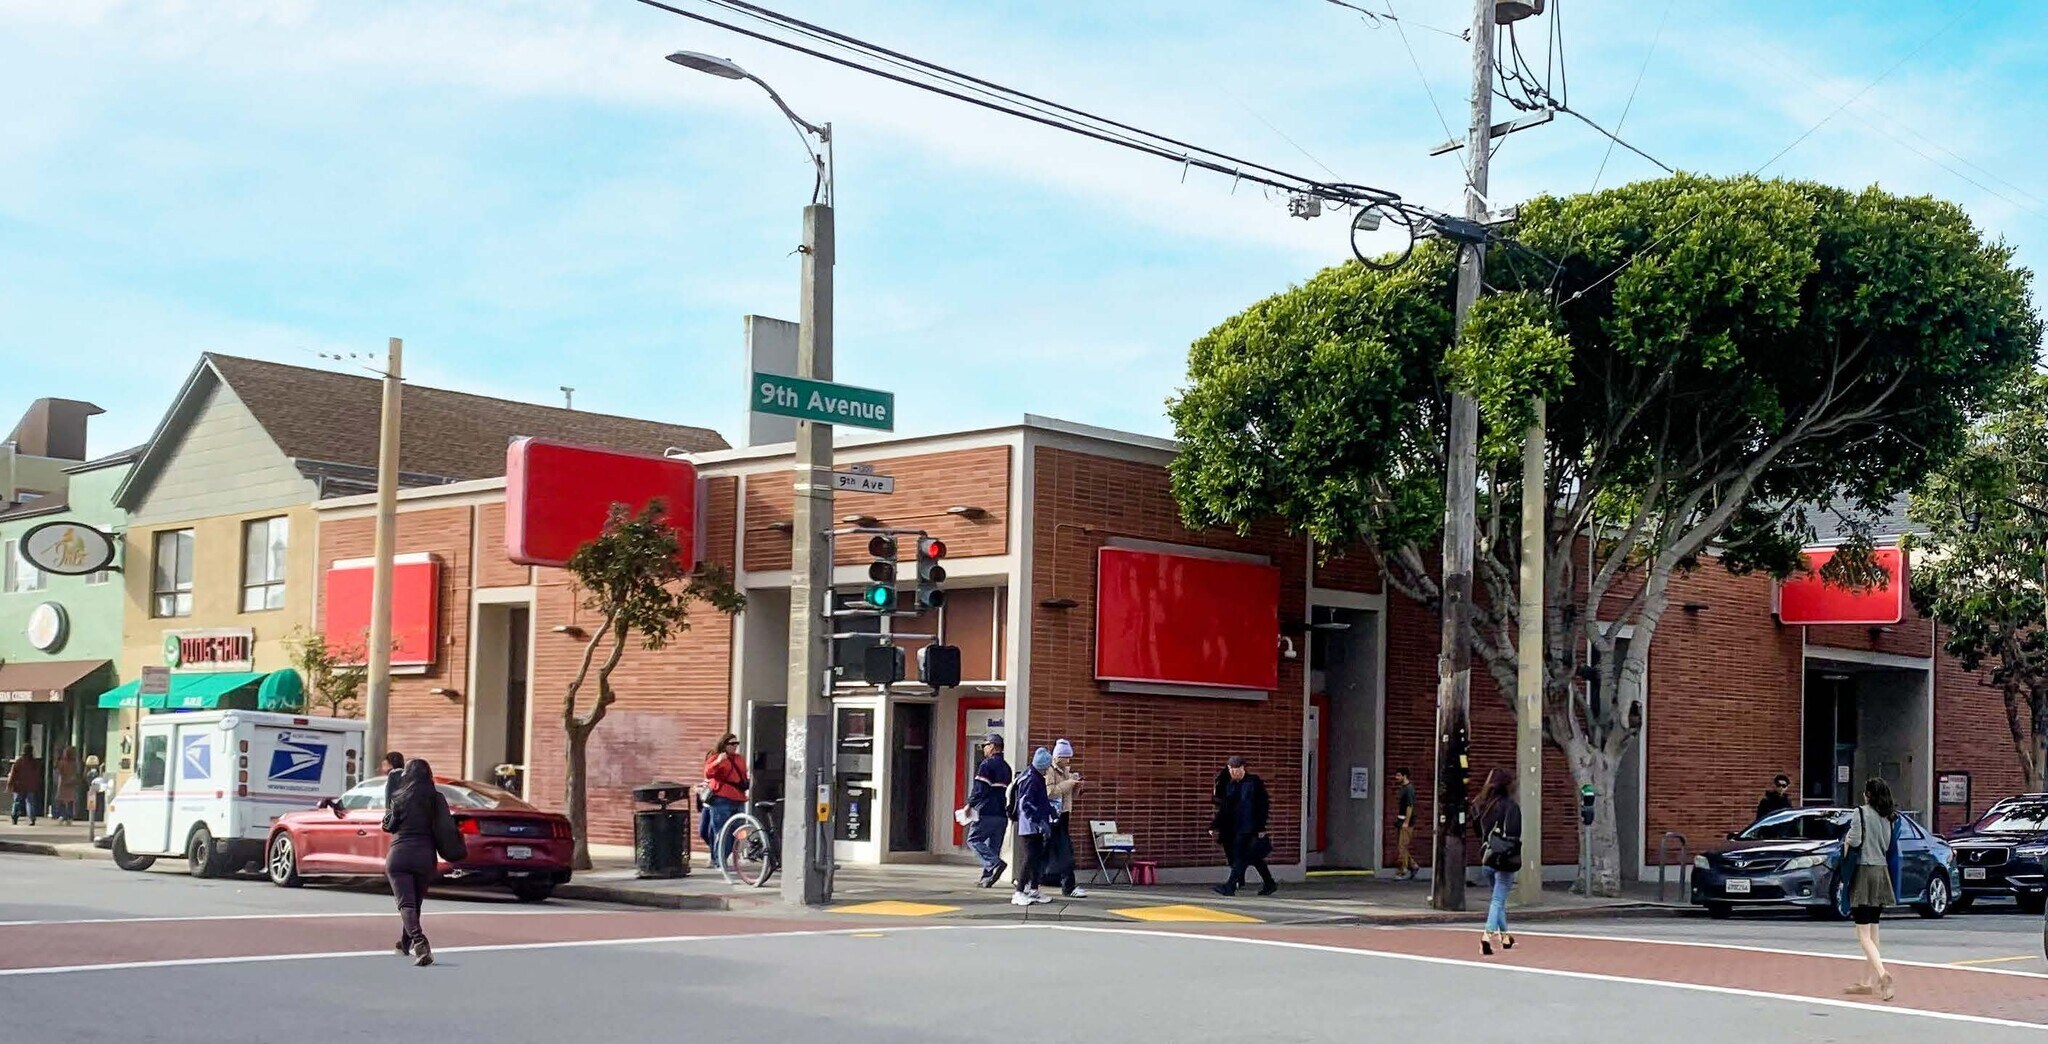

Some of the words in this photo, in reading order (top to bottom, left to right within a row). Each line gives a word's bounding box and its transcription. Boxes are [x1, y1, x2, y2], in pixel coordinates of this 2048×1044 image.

[760, 382, 799, 408] 9th
[807, 390, 887, 421] Avenue
[839, 476, 856, 487] 9th
[862, 478, 884, 491] Ave
